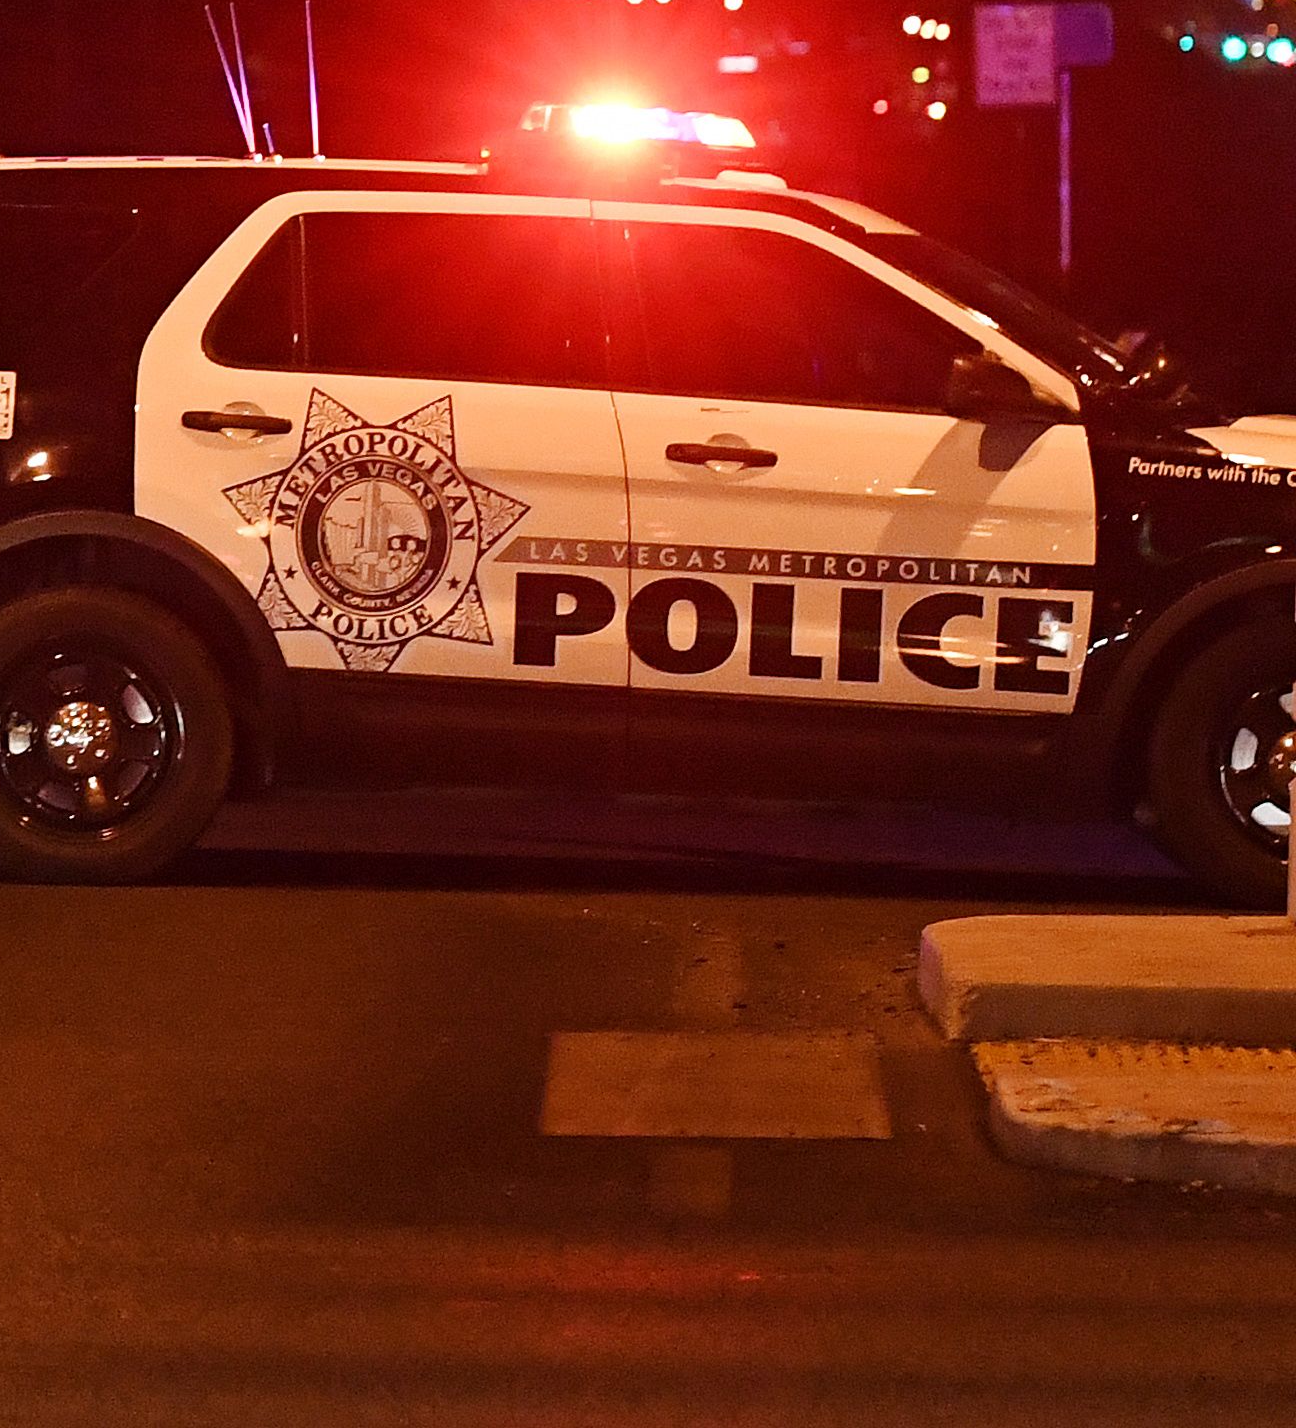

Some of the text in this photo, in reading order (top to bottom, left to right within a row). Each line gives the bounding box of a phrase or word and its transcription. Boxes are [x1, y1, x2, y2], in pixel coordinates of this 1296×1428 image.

[274, 432, 475, 542] METROPOLITAN
[315, 462, 439, 512] LAS VEGAS
[1128, 456, 1202, 480] Partners
[1207, 464, 1246, 483] with
[1251, 468, 1281, 486] the
[530, 542, 1031, 584] LAS VEGAS METROPOLITAN
[309, 601, 434, 641] POLICE
[513, 572, 1074, 695] POLICE
